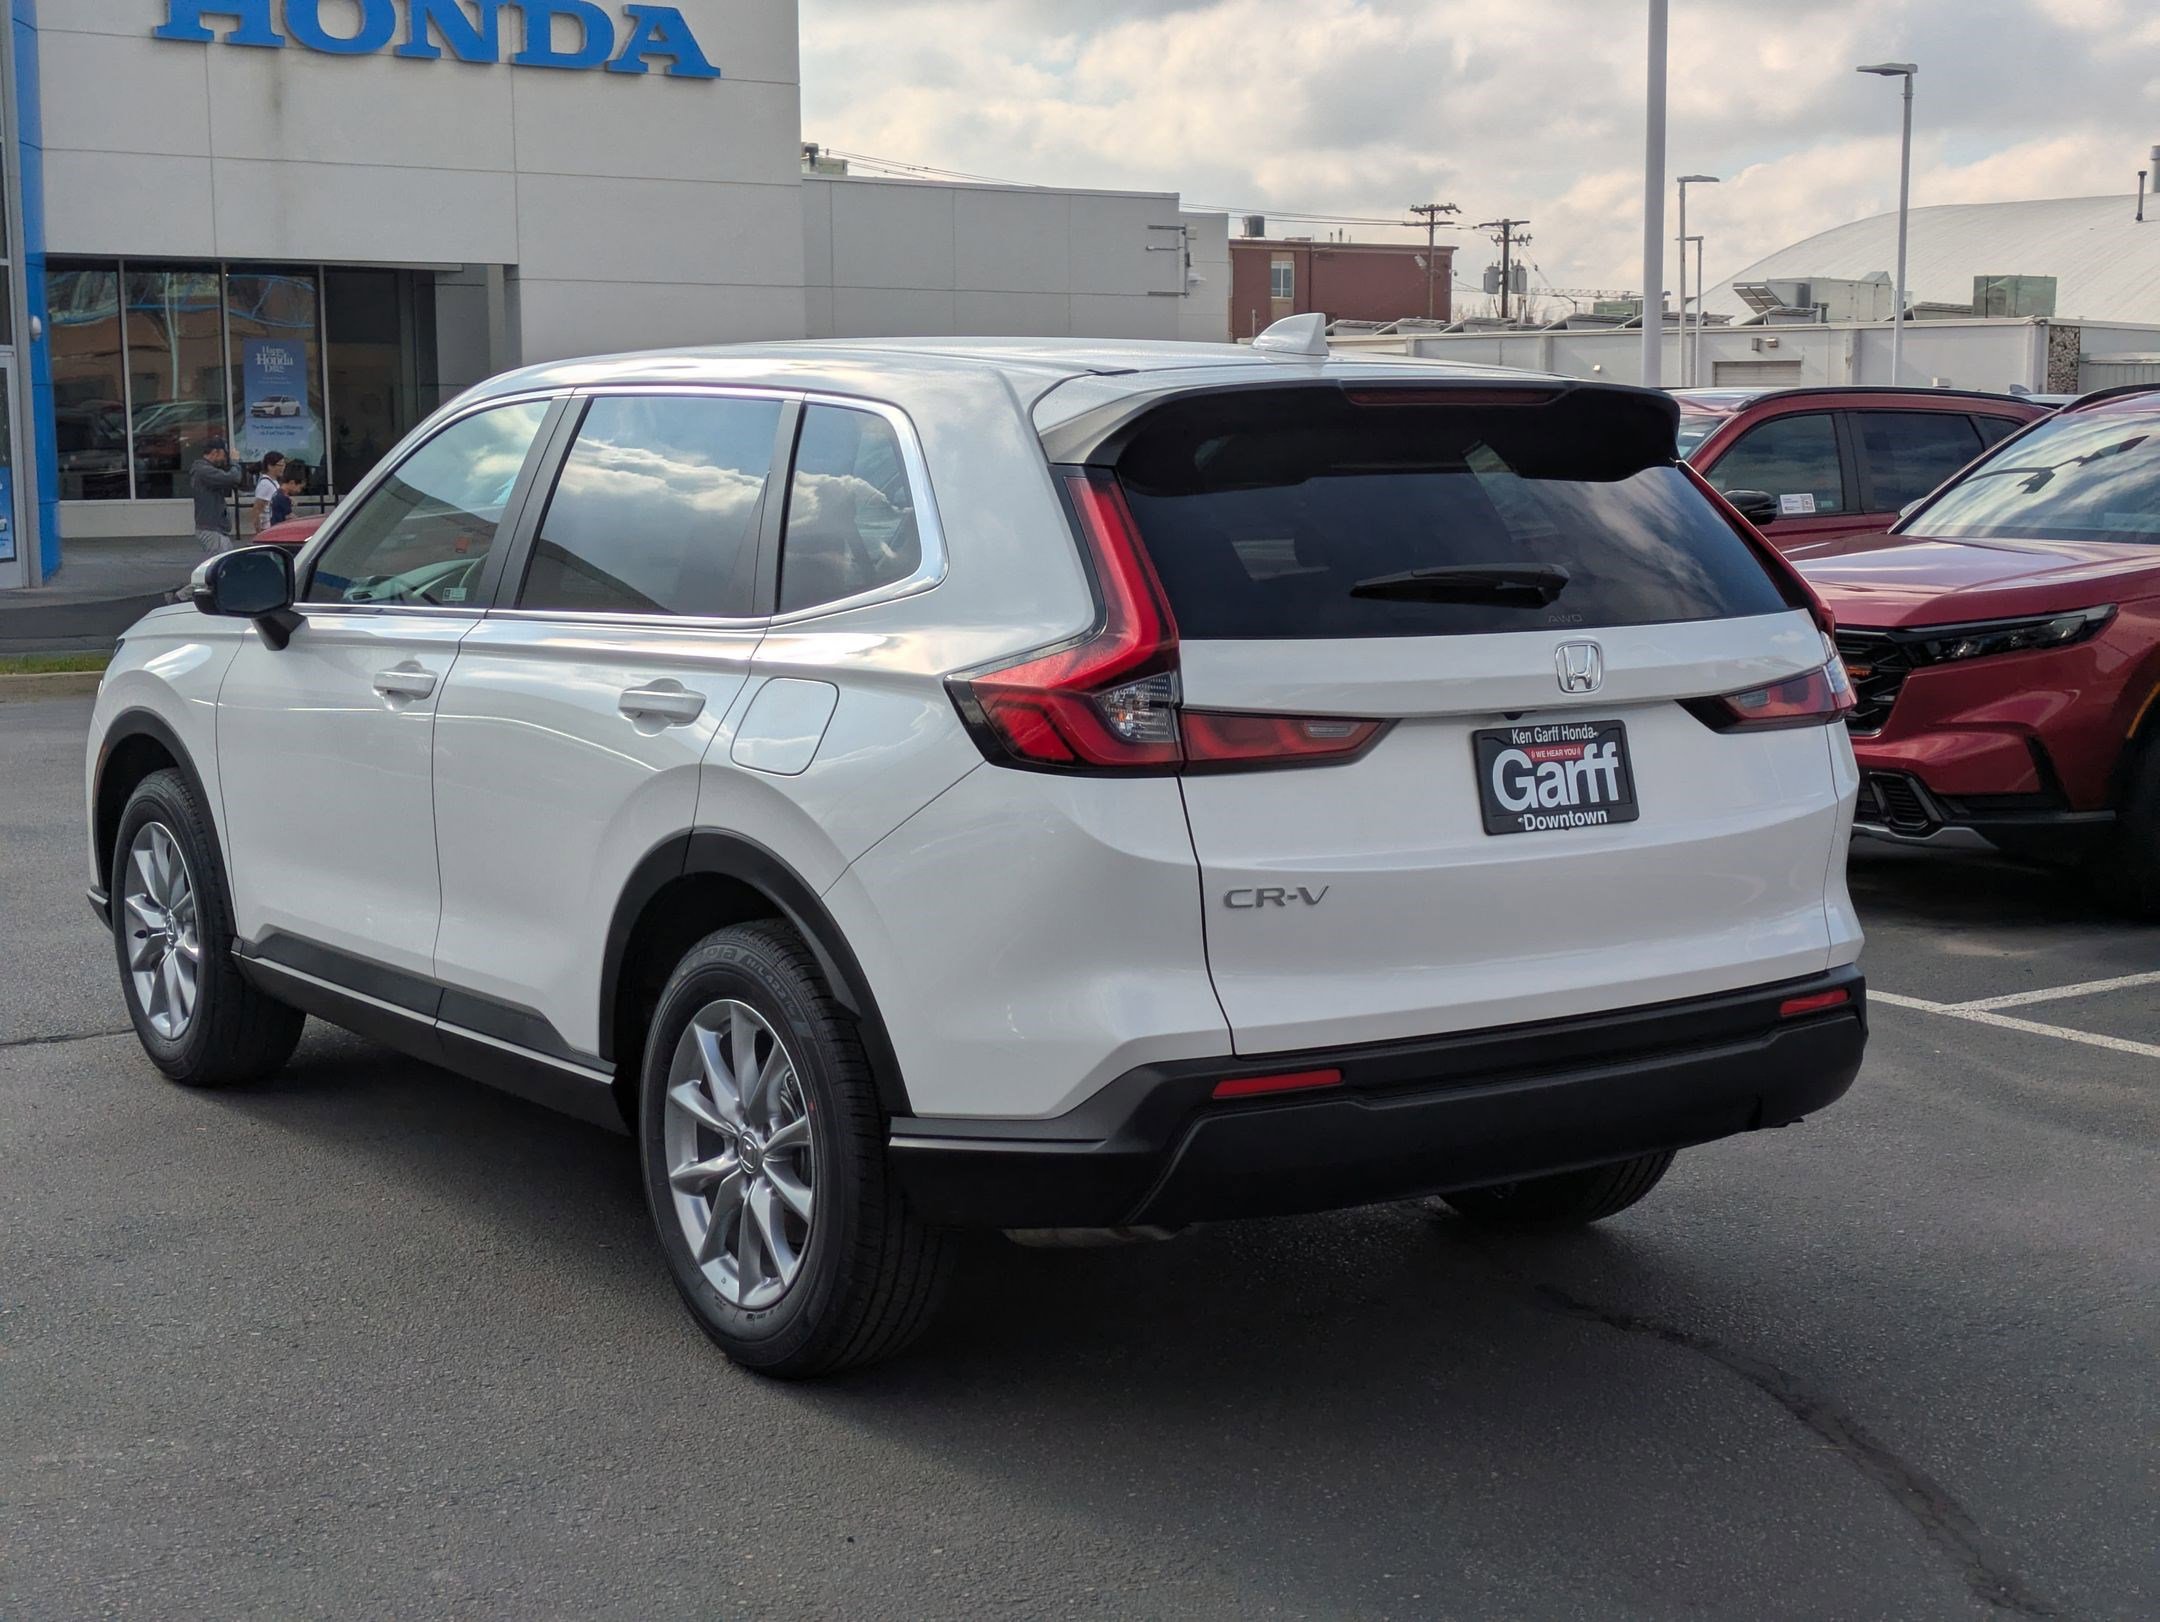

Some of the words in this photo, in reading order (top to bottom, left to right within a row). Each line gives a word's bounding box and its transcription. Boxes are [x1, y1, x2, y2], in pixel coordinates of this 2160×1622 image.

[152, 0, 721, 78] HONDA
[1511, 729, 1532, 744] Ken
[1534, 725, 1559, 743] Garff
[1561, 724, 1594, 741] Honda
[1535, 749, 1546, 758] WE
[1546, 748, 1563, 757] HEAR
[1564, 747, 1577, 756] YOU
[1492, 741, 1619, 811] Garff
[1523, 810, 1608, 831] Downtown
[1223, 885, 1330, 909] CR-V
